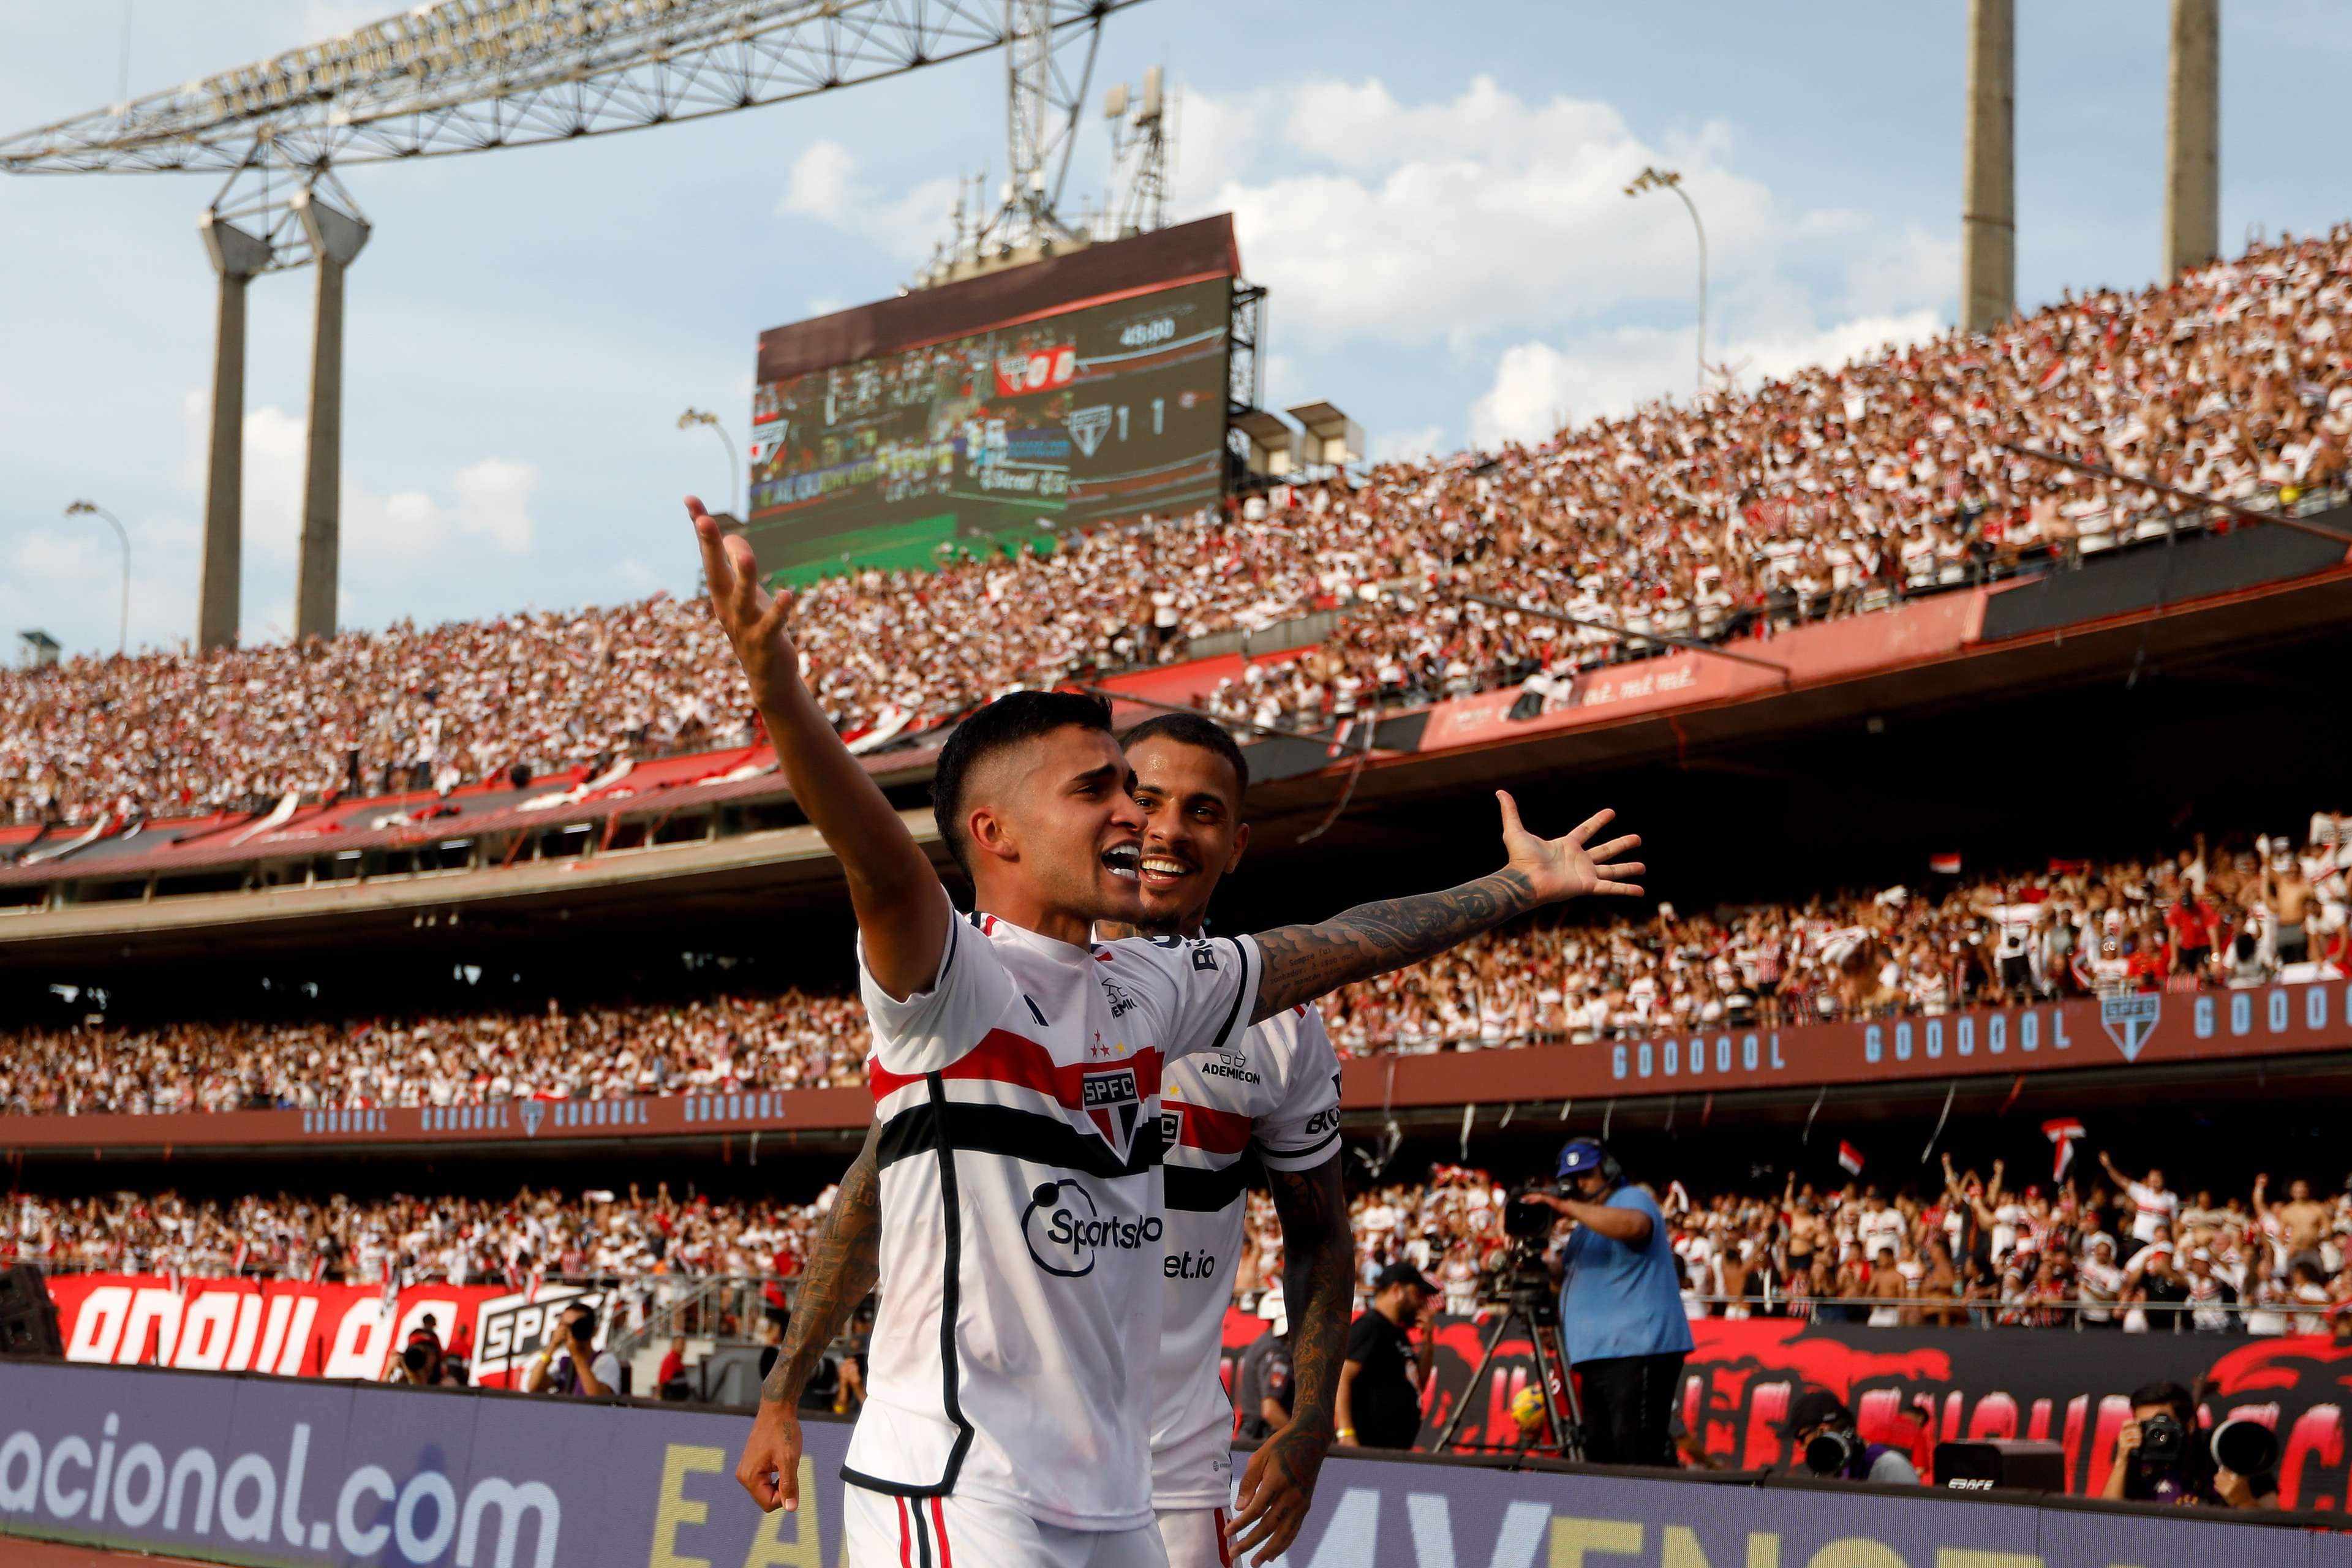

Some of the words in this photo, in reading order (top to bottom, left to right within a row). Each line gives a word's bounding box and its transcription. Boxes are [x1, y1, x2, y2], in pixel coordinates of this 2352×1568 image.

[1202, 1063, 1260, 1085] ADEMICON
[1084, 1077, 1133, 1101] SPFC
[483, 1293, 604, 1360] SPF
